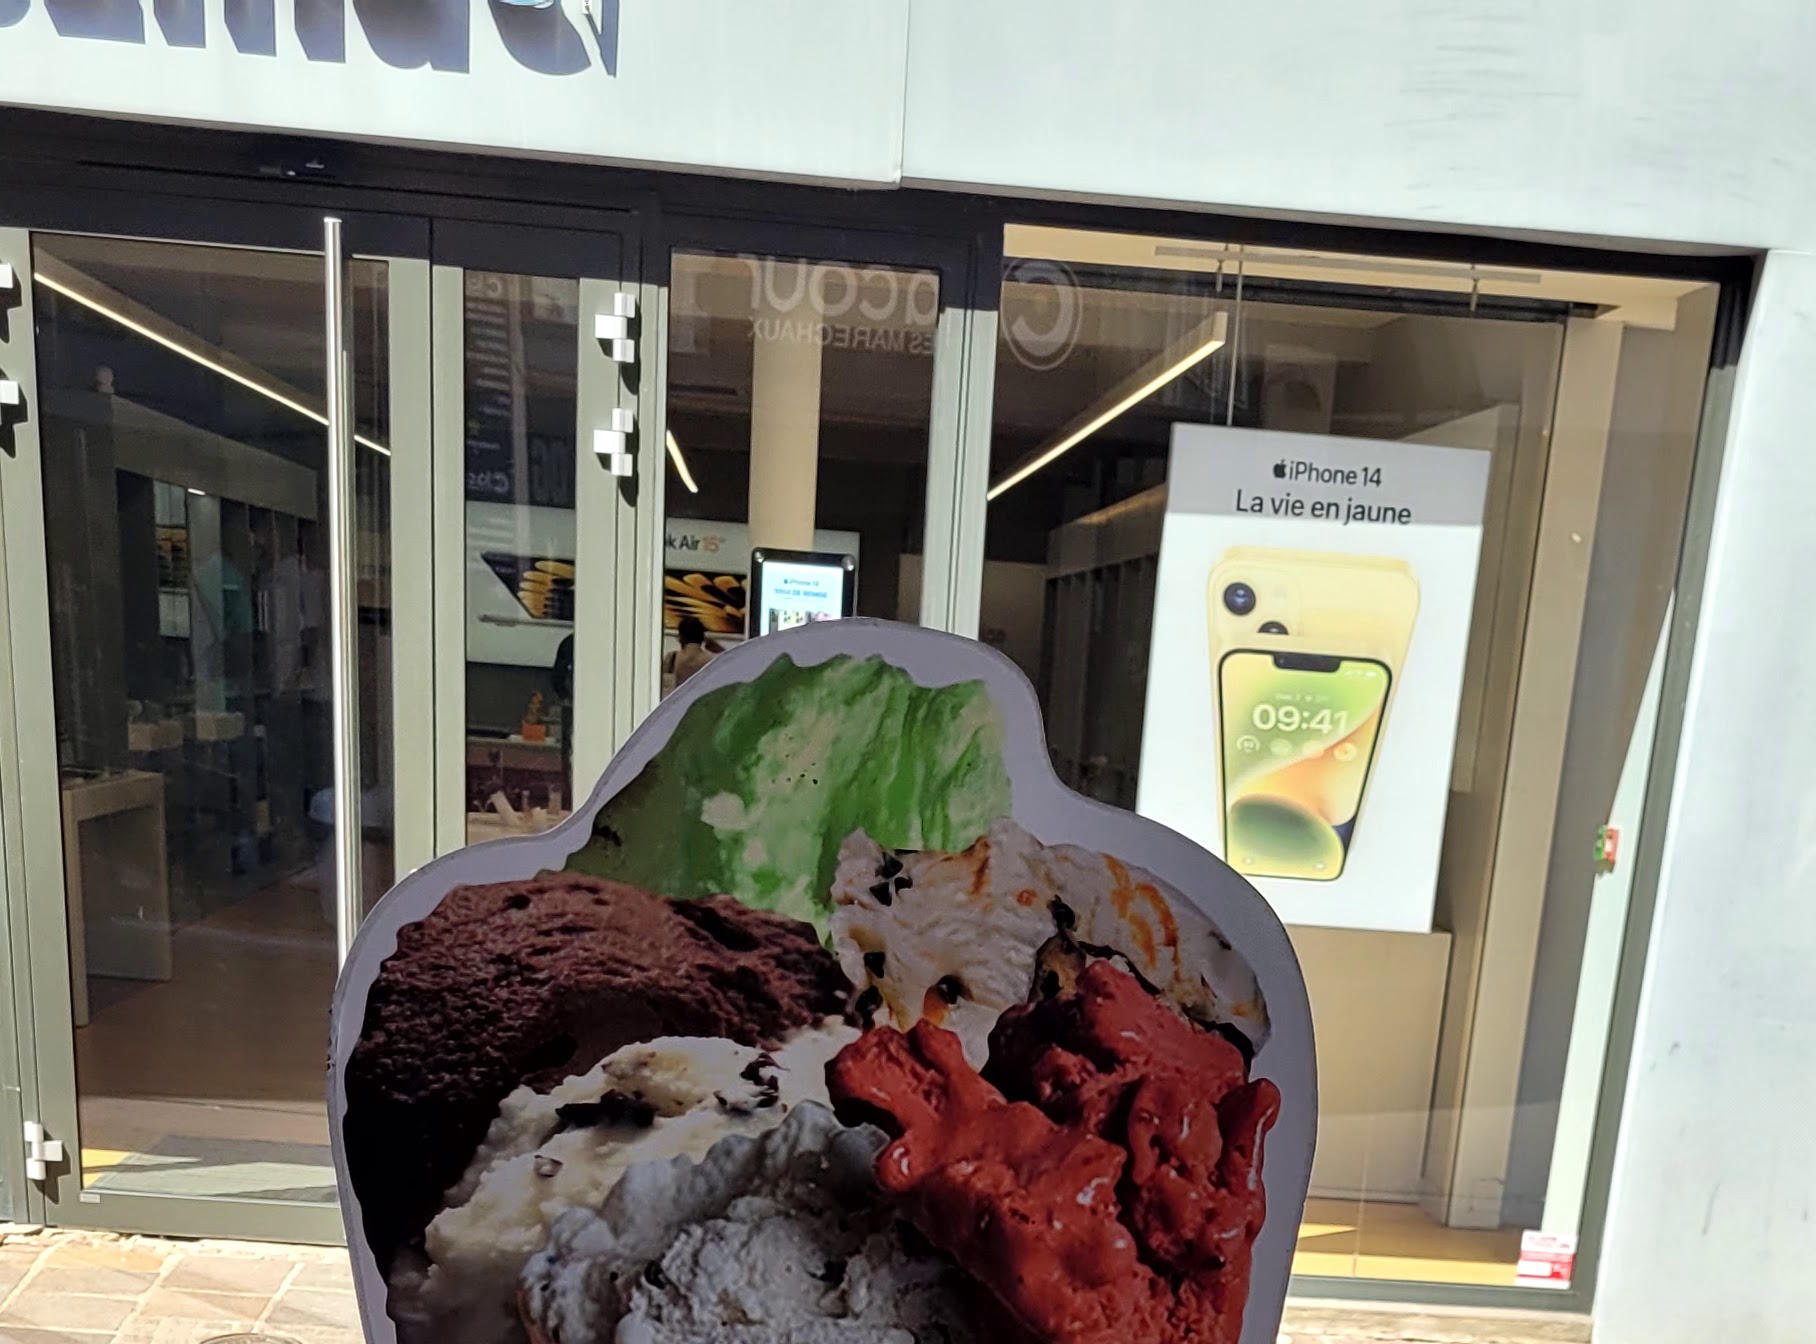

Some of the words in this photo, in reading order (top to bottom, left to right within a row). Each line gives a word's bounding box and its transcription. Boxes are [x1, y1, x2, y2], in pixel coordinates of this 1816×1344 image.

[1288, 460, 1358, 486] iPhone
[1362, 466, 1382, 488] 14
[1235, 488, 1264, 514] La
[1271, 492, 1305, 517] vie
[1311, 500, 1340, 520] en
[1343, 497, 1412, 526] jaune
[679, 534, 701, 551] Air
[1252, 703, 1350, 735] 09:41
